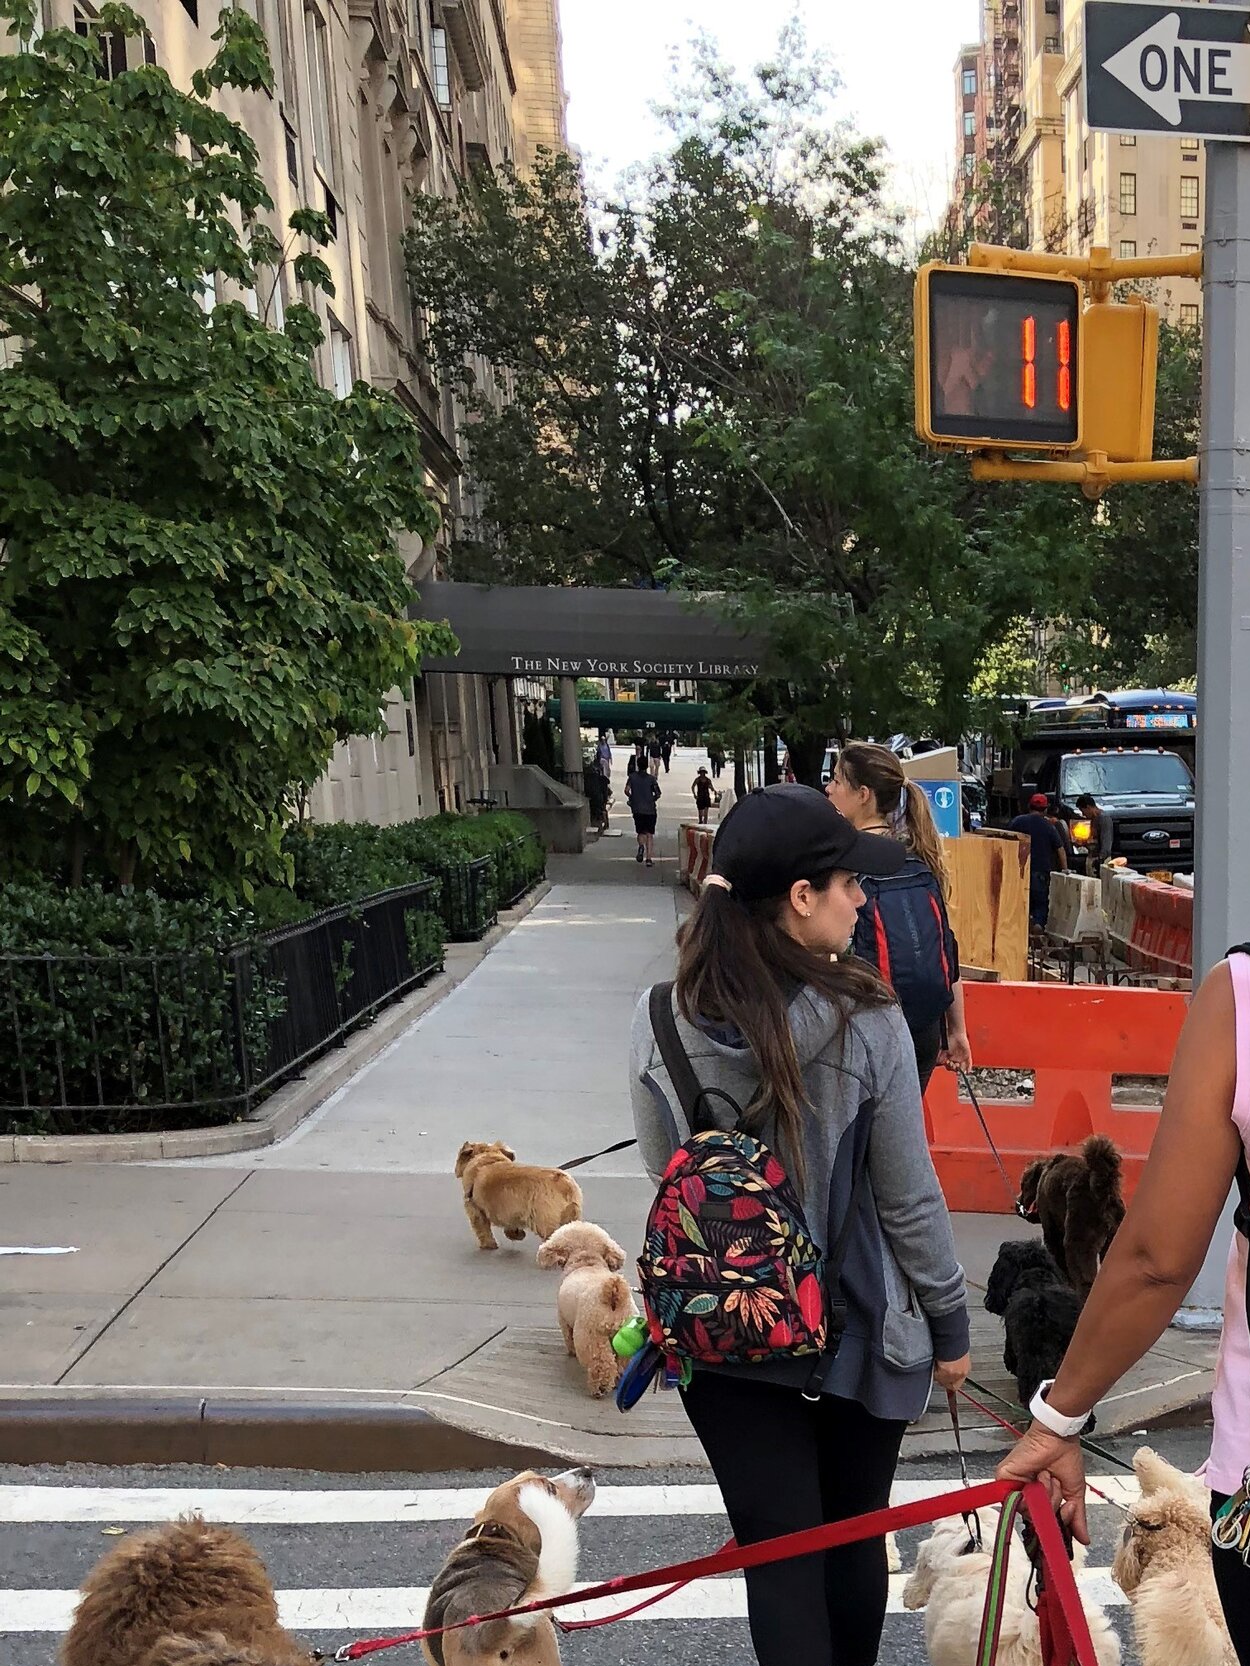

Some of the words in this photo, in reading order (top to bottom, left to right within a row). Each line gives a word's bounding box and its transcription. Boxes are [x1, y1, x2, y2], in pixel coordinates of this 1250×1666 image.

[1139, 44, 1233, 96] ONE
[1022, 315, 1071, 410] 11
[511, 656, 543, 671] THE
[547, 657, 582, 672] NEW
[586, 658, 629, 673] YORK
[633, 660, 694, 675] SOCIETY
[698, 661, 760, 676] LIBRARY
